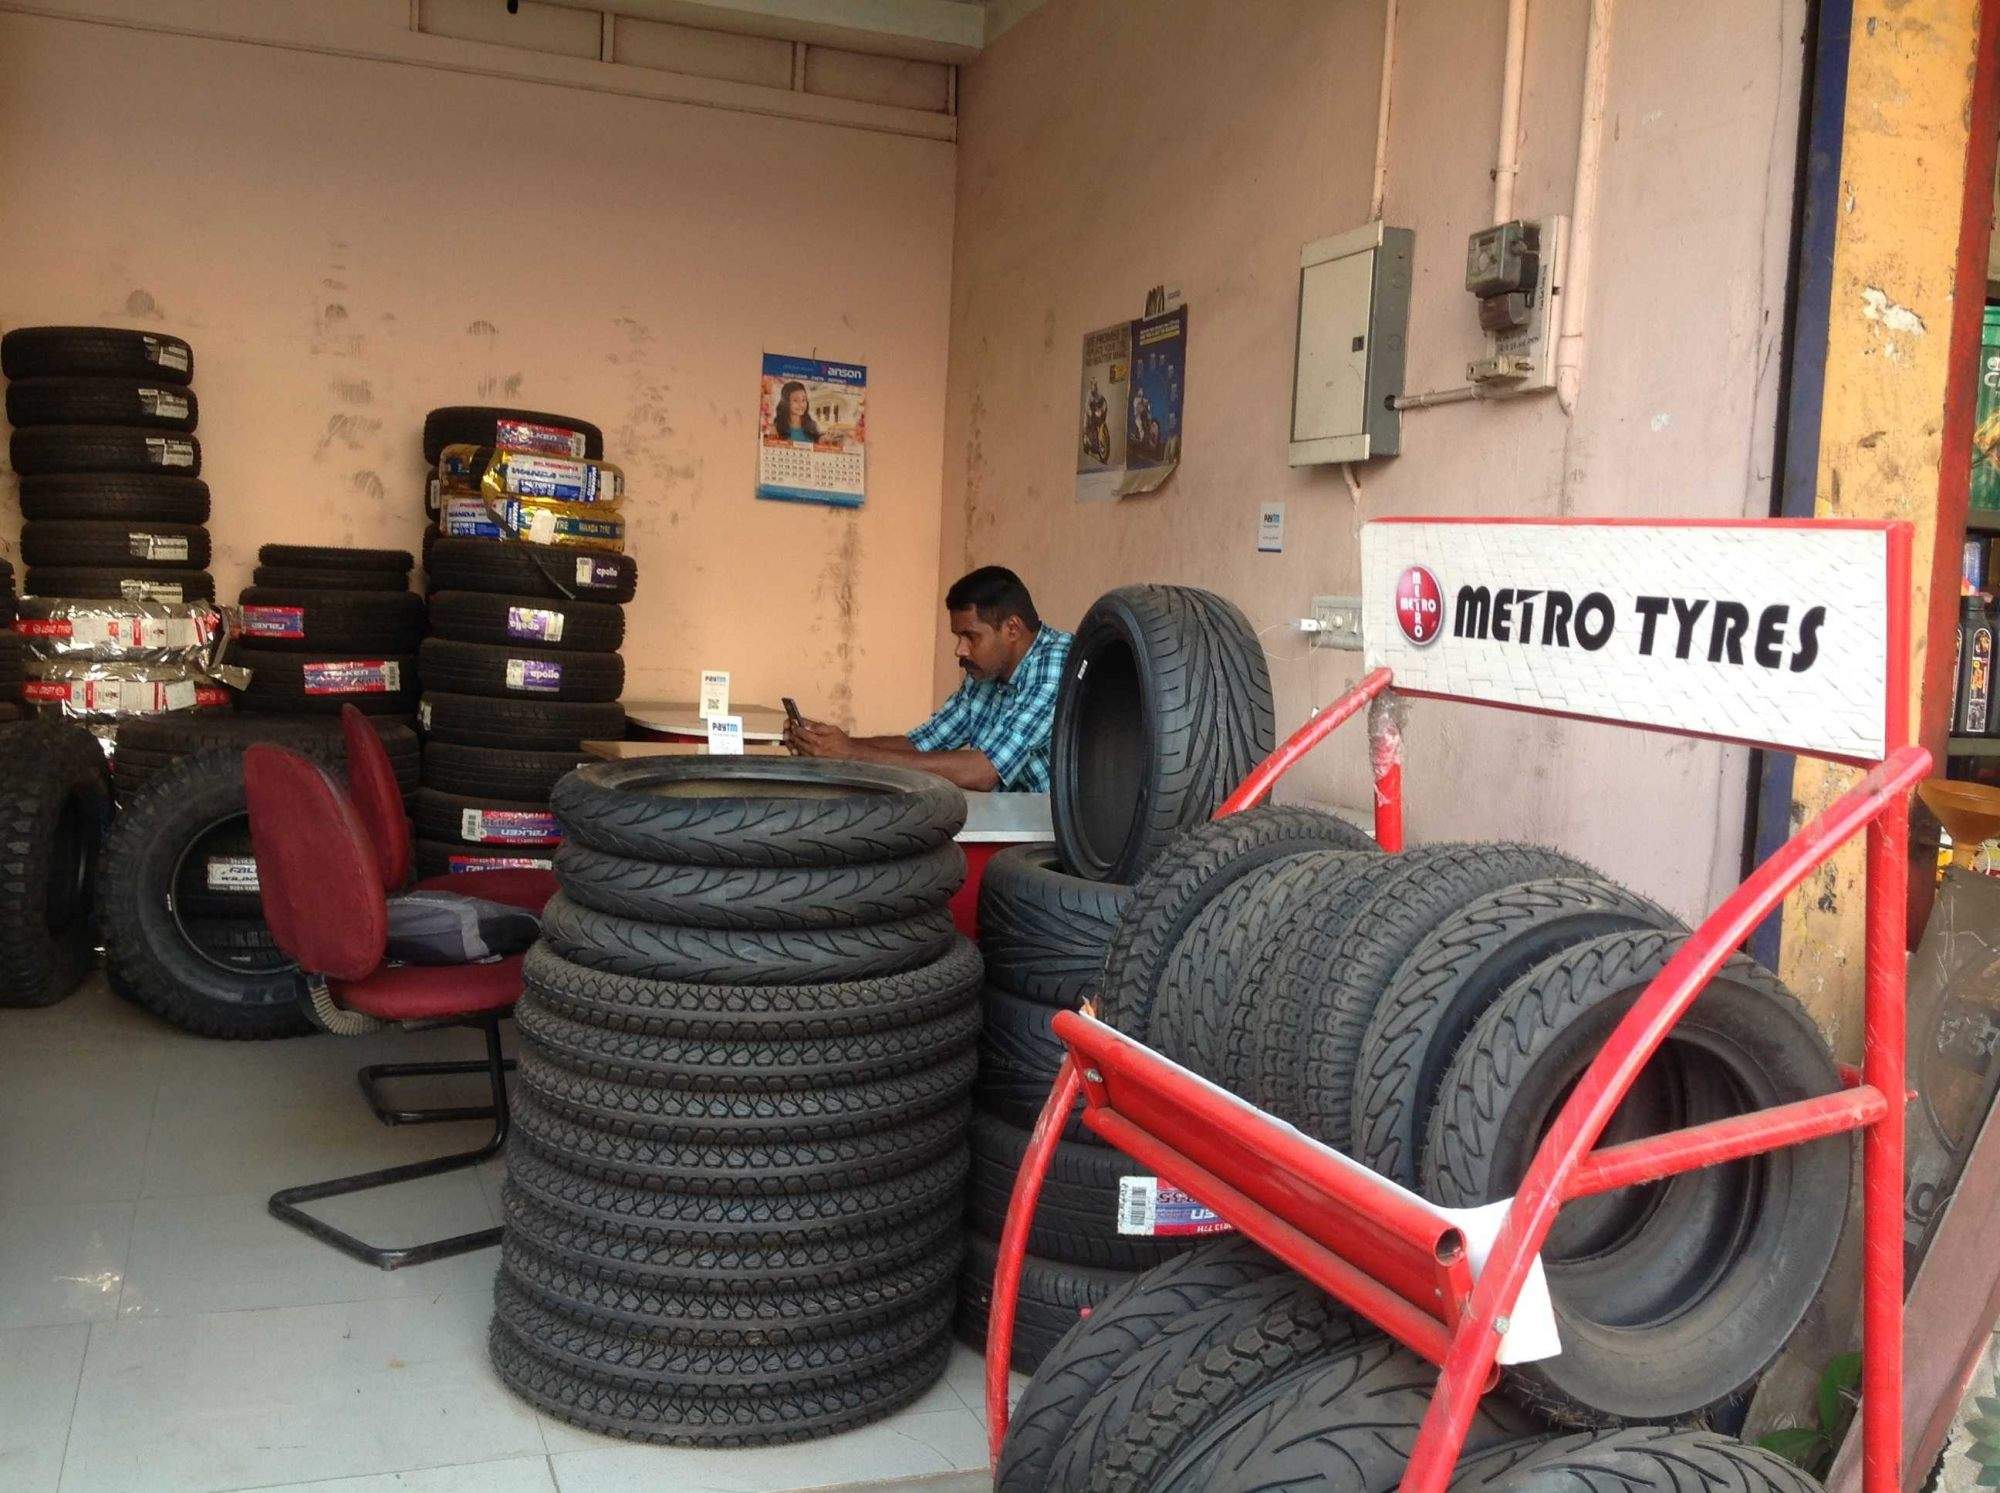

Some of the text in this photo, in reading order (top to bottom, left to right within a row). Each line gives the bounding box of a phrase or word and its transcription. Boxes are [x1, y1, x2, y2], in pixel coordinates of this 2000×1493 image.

[827, 366, 862, 379] anson
[596, 567, 618, 577] apollo
[1454, 585, 1827, 673] METRO TYRES
[530, 669, 560, 681] apollo
